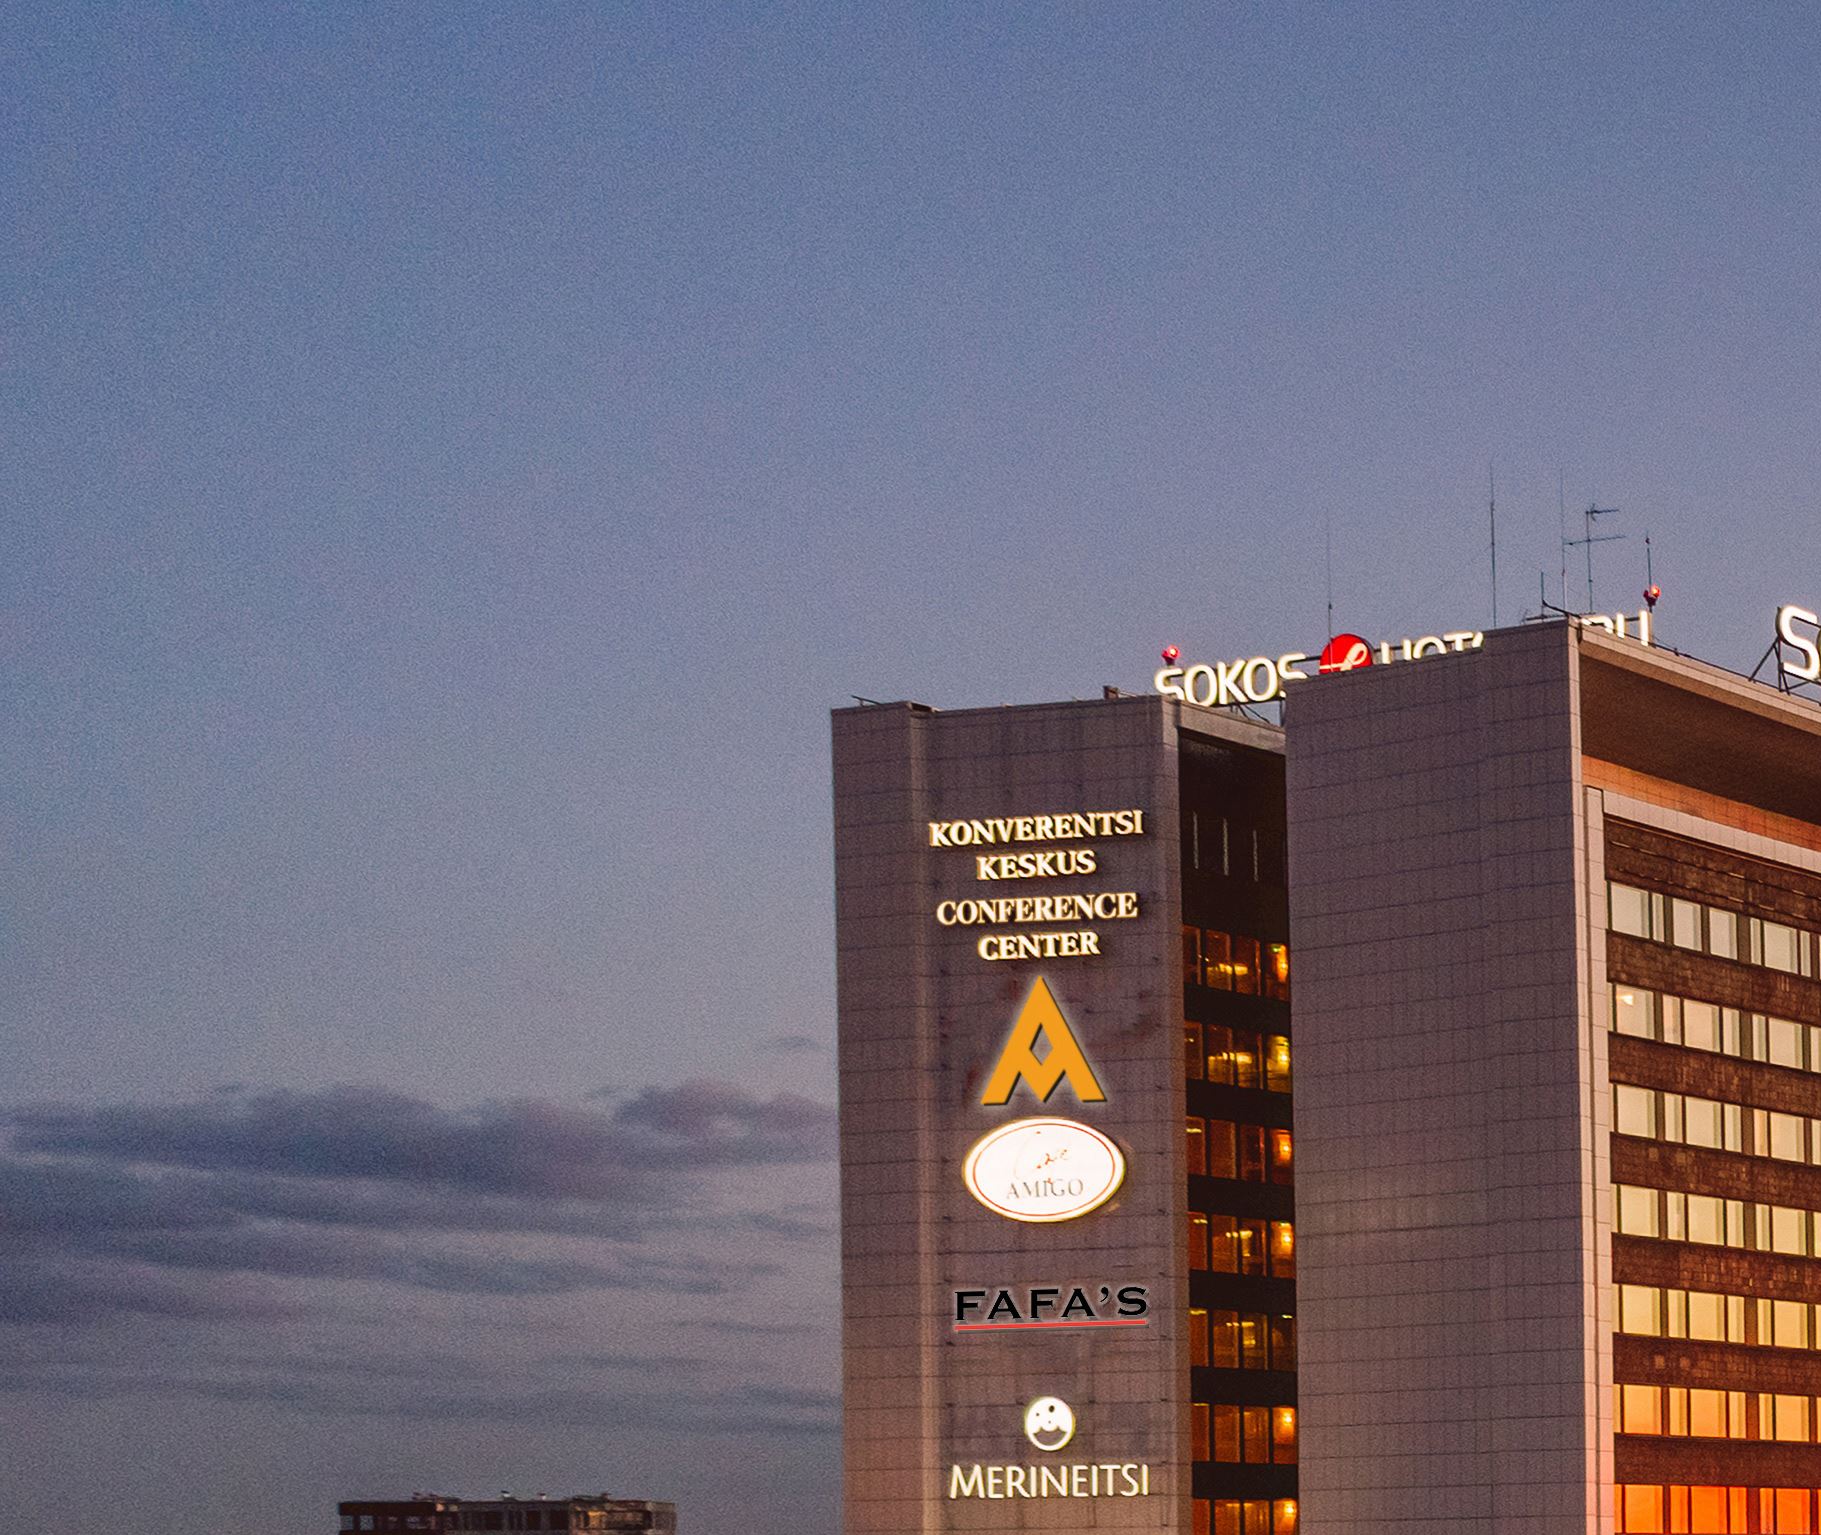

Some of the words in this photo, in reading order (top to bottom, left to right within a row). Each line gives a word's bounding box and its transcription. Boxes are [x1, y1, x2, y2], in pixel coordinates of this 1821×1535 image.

[1154, 653, 1308, 706] SOKOS
[928, 810, 1144, 847] KONVERENTSI
[976, 850, 1097, 880] KESKUS
[936, 893, 1138, 926] CONFERENCE
[978, 930, 1101, 961] CENTER
[1006, 1177, 1085, 1200] AMIGO
[949, 1463, 1150, 1500] MERINEITSI
